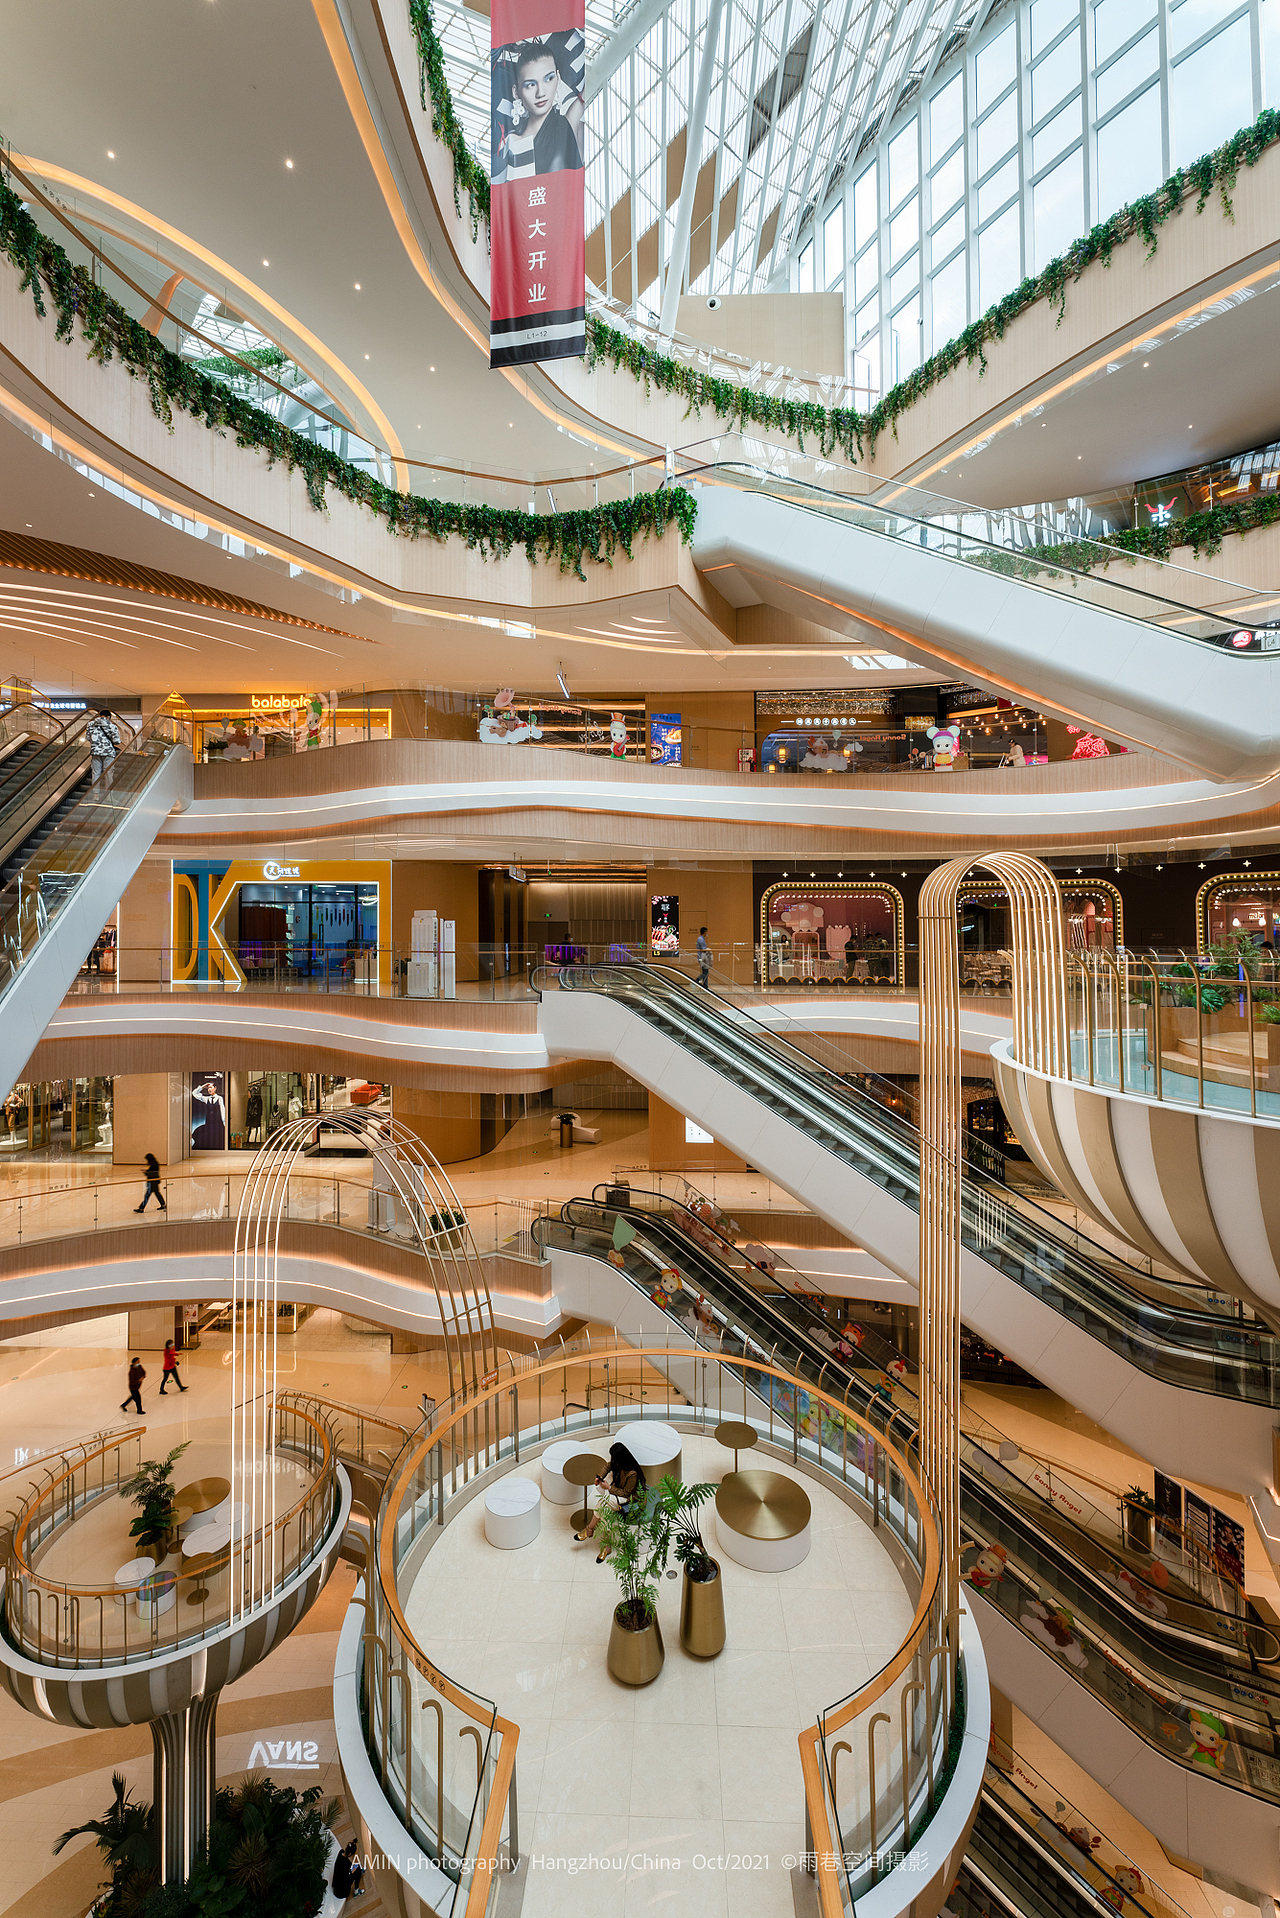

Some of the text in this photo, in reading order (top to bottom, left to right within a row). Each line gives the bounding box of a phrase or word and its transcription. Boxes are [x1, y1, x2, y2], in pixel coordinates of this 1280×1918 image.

[527, 186, 547, 304] 盛大开业
[1033, 1473, 1083, 1514] Sonny Angel
[1015, 1767, 1039, 1790] Angel
